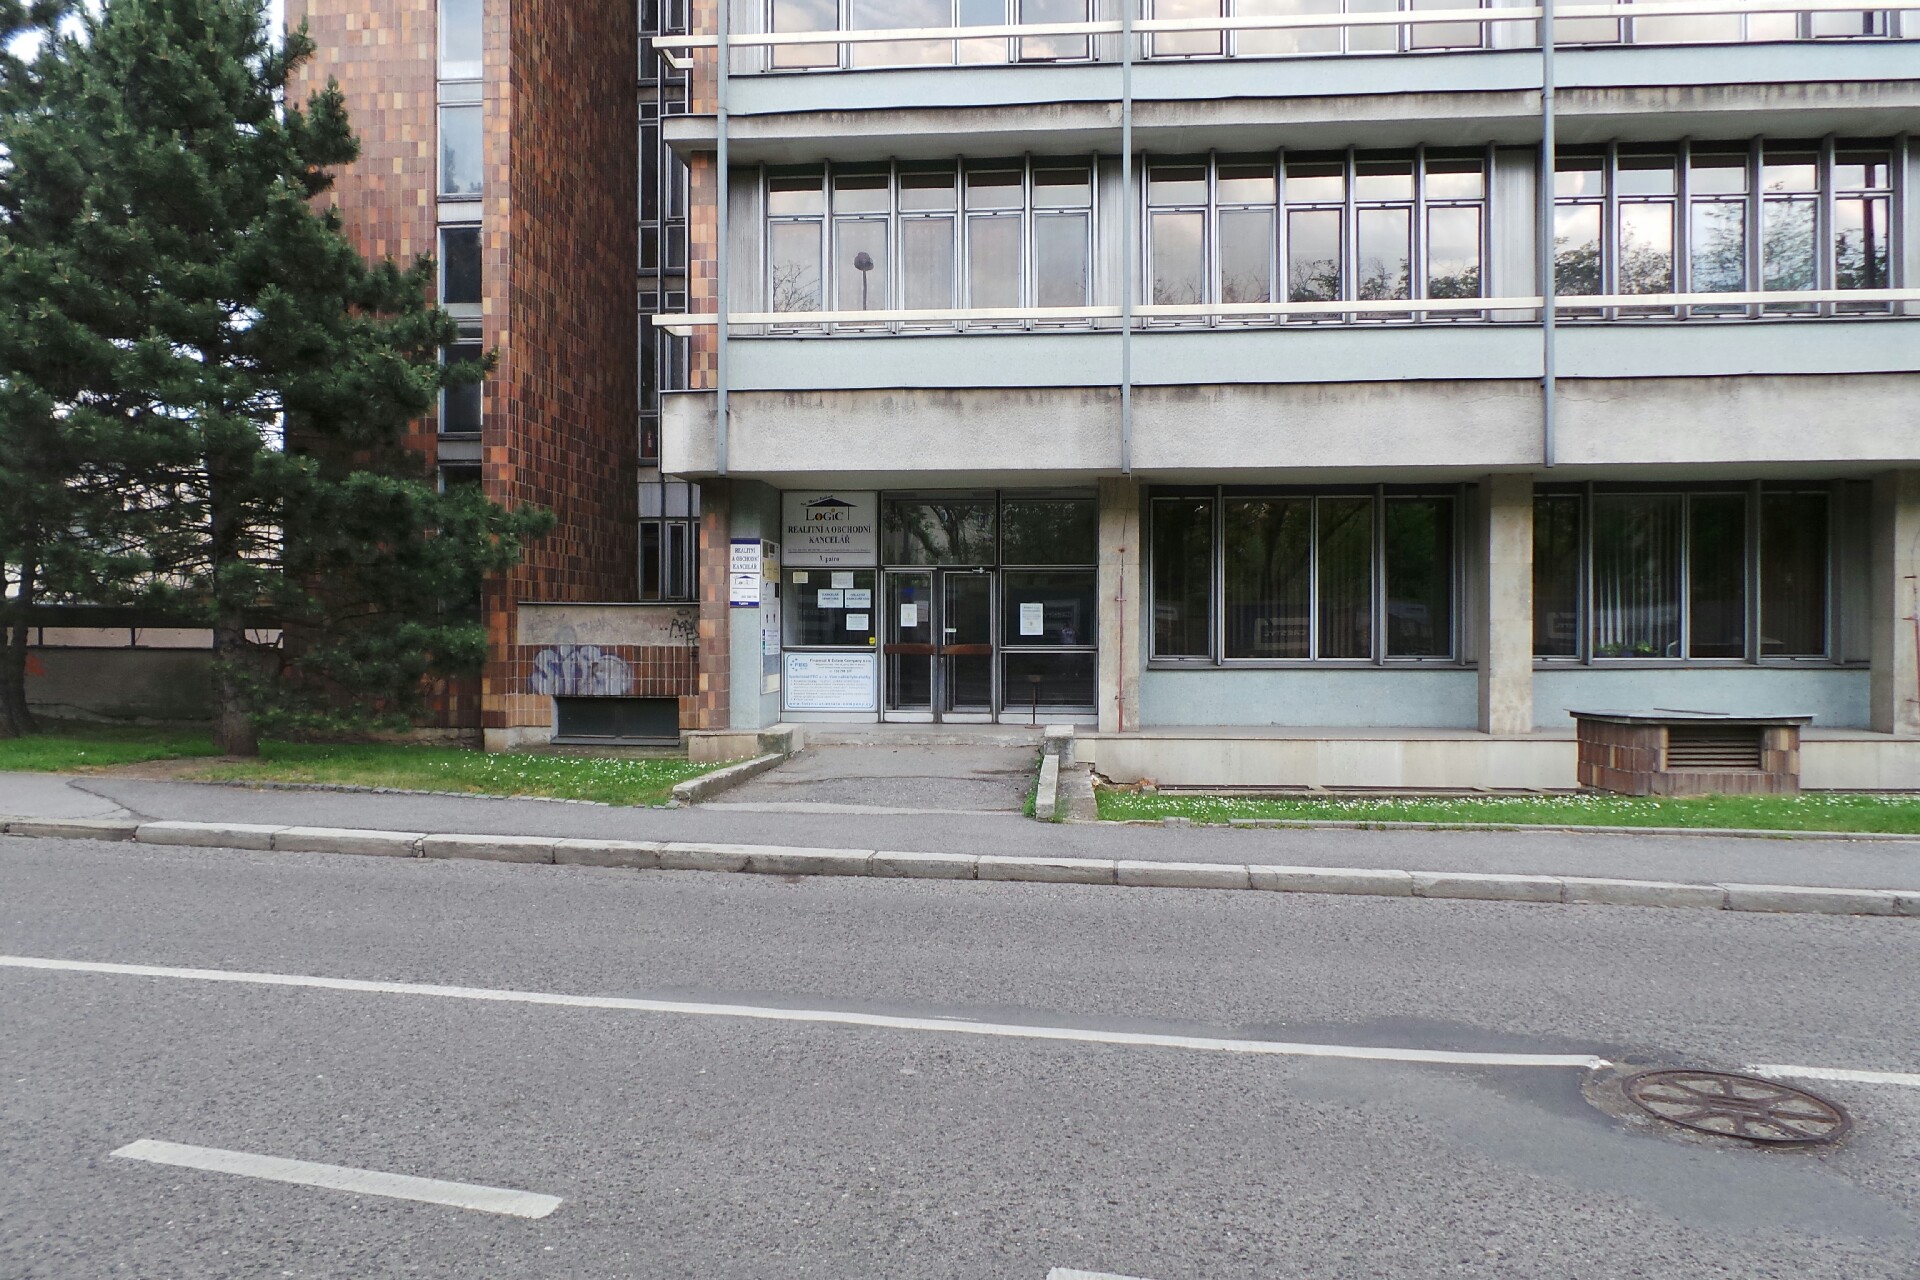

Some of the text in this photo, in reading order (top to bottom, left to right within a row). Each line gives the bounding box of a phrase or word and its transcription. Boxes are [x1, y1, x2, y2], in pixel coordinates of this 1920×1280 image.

[788, 524, 871, 534] REALITNÍ A OBCHODNÍ
[809, 534, 850, 544] KANCELÁŘ
